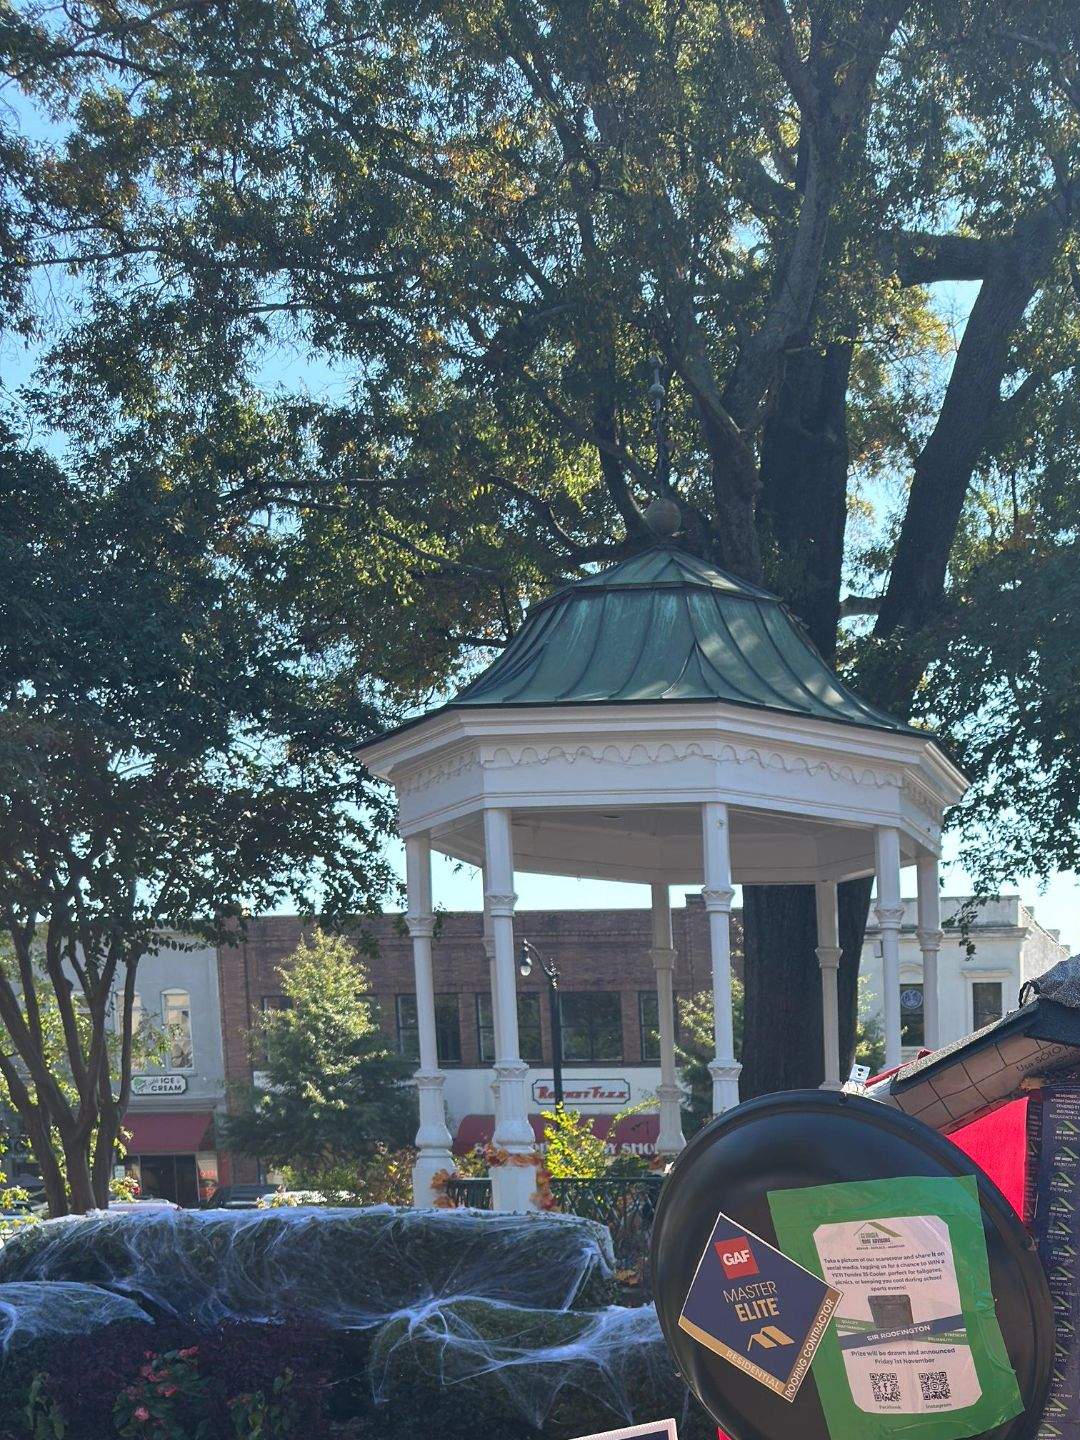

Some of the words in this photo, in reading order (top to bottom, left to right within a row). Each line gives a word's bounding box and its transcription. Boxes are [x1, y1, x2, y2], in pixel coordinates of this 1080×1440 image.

[723, 1250, 750, 1266] GAF
[723, 1281, 778, 1303] MASTER
[735, 1298, 780, 1322] ELITE
[880, 1325, 930, 1340] ROOFINGTON
[785, 1359, 807, 1398] ROOFING
[804, 1298, 835, 1357] CONTRACTOR
[726, 1350, 780, 1389] RESIDENTIAL
